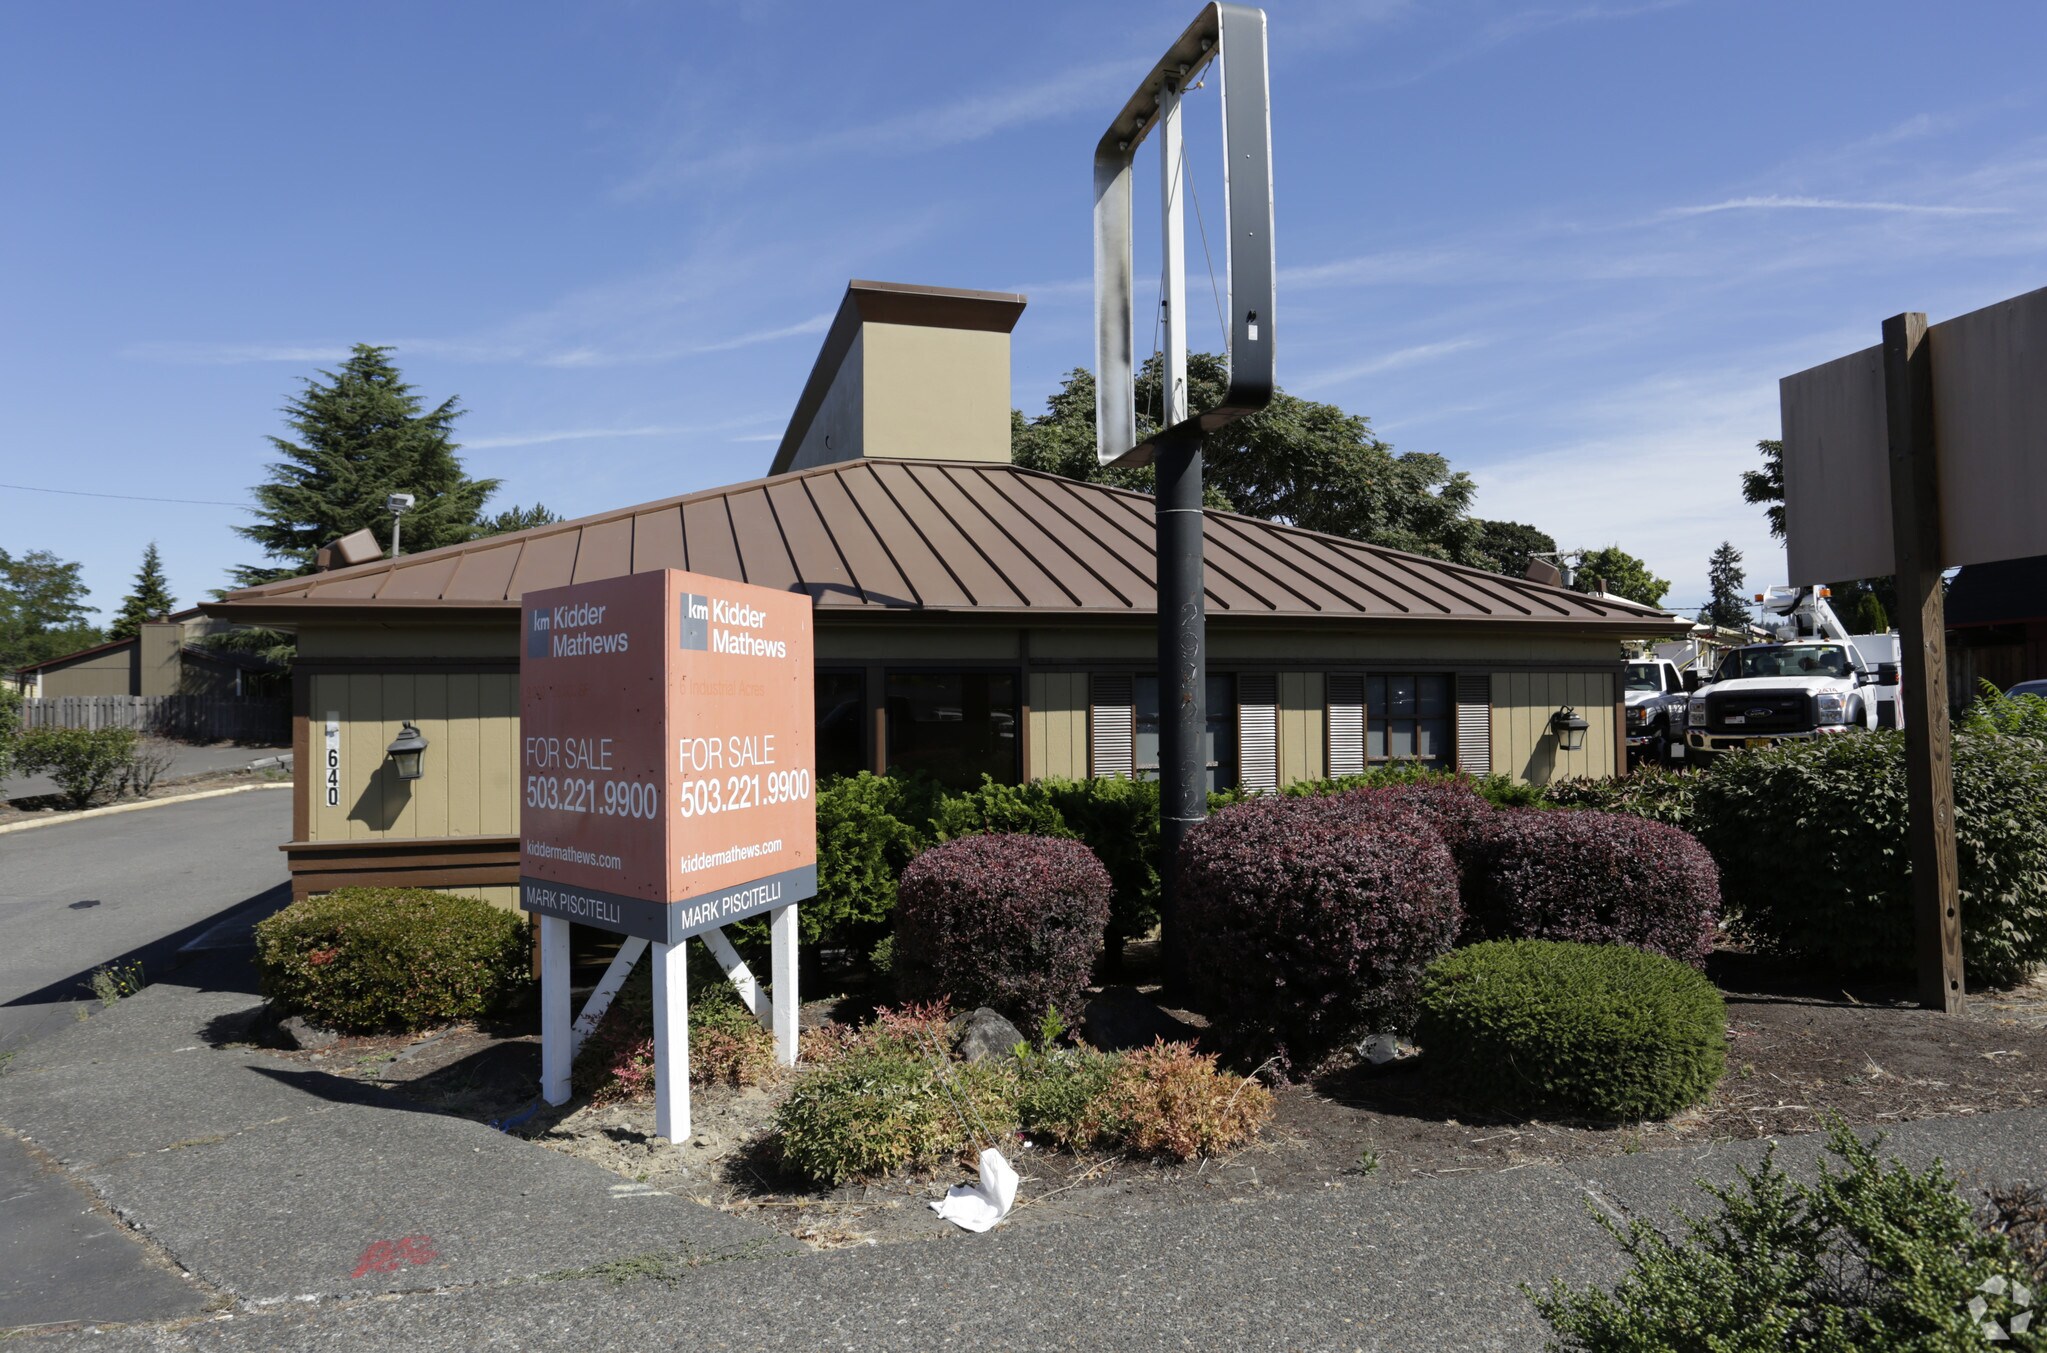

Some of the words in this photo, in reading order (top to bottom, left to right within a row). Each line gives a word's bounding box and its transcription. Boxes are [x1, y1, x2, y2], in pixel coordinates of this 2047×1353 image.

[534, 610, 550, 631] km
[554, 602, 606, 629] Kidder
[688, 593, 708, 620] km
[713, 598, 766, 628] Kidder
[553, 632, 629, 657] Mathews
[713, 629, 786, 658] Mathews
[526, 737, 560, 768] FOR
[565, 738, 613, 770] SALE
[680, 737, 722, 772] FOR
[728, 735, 775, 767] SALE
[527, 775, 657, 819] 503.221.9900
[681, 768, 810, 818] 503.221.9900
[527, 840, 621, 870] kiddermathews.com
[681, 839, 782, 874] kiddermathews.com
[526, 886, 557, 909] MARK
[560, 893, 620, 924] PISCITELLI
[681, 900, 719, 930] MARK
[722, 881, 781, 917] PISCITELLI
